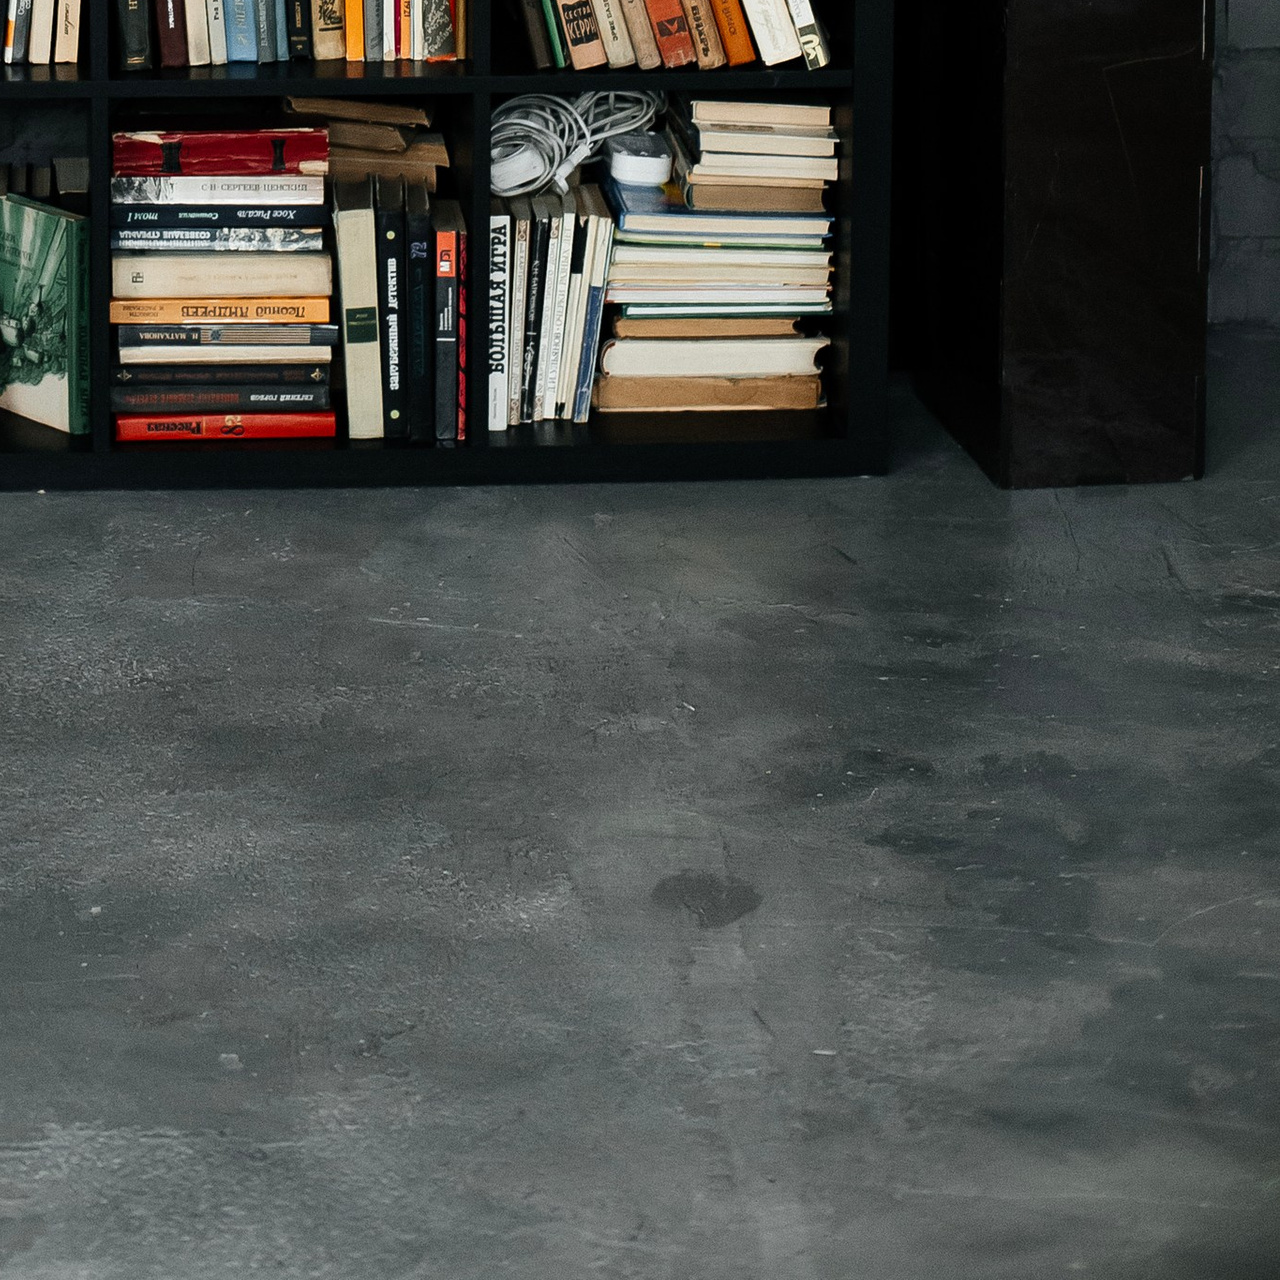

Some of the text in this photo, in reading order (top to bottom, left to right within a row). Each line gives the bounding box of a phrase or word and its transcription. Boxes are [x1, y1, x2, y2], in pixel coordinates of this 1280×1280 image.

[689, 5, 711, 58] ВИХРЬ
[722, 5, 739, 37] ЮРИЙ
[272, 208, 297, 219] Хосе
[117, 229, 210, 240] СОЗВЕЗДИЕ СТРЕЛЬЦА
[543, 269, 555, 301] ТИХОГО
[554, 226, 573, 328] ОЧЕРКИ РАЗНЫХ ЛЕТ
[180, 304, 307, 319] Леонид АНДРЕЕВ
[488, 224, 507, 375] БОЛЬШАЯ ИГРА
[385, 257, 400, 391] ЗАРУБЕЖНЫЙ ДЕТЕКТИВ
